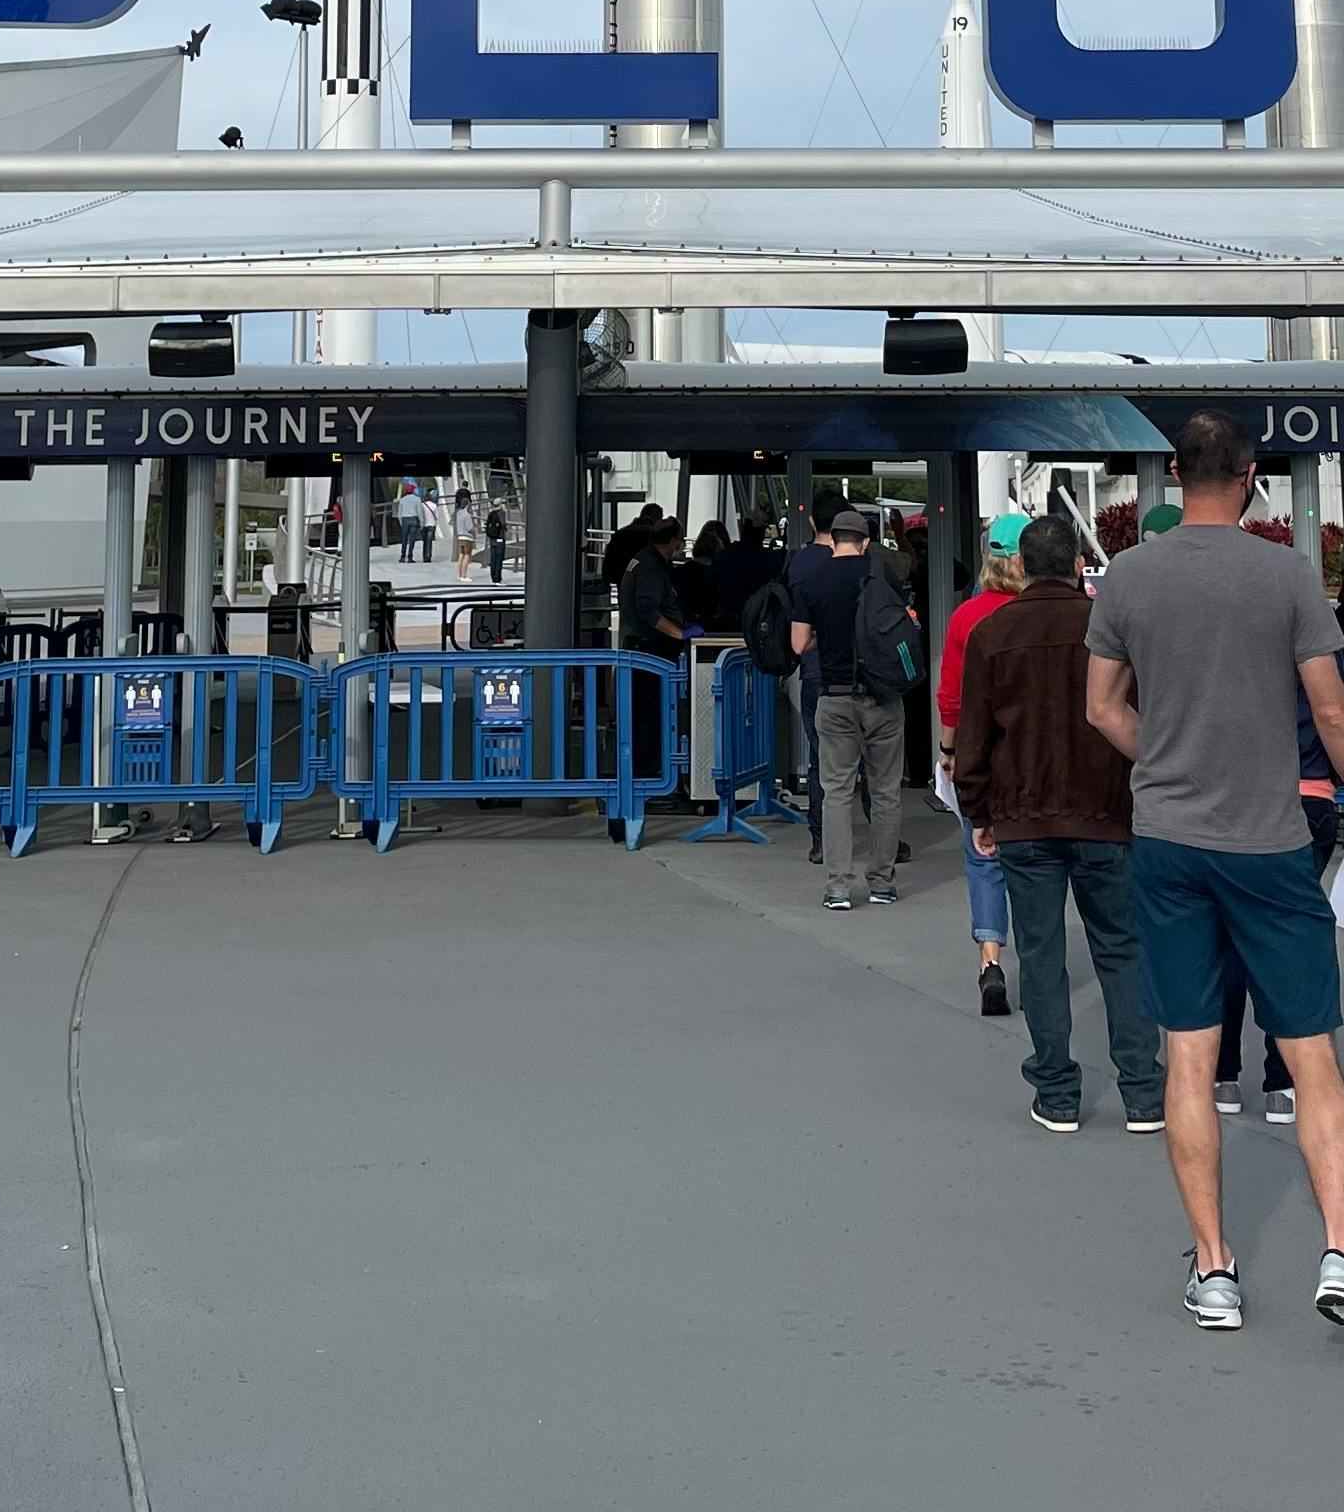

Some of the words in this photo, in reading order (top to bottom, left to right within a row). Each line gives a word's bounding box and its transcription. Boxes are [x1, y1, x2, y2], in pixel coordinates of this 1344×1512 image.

[952, 16, 968, 31] 19
[940, 44, 949, 136] UNITED
[14, 409, 105, 446] THE
[135, 406, 374, 445] JOURNEY
